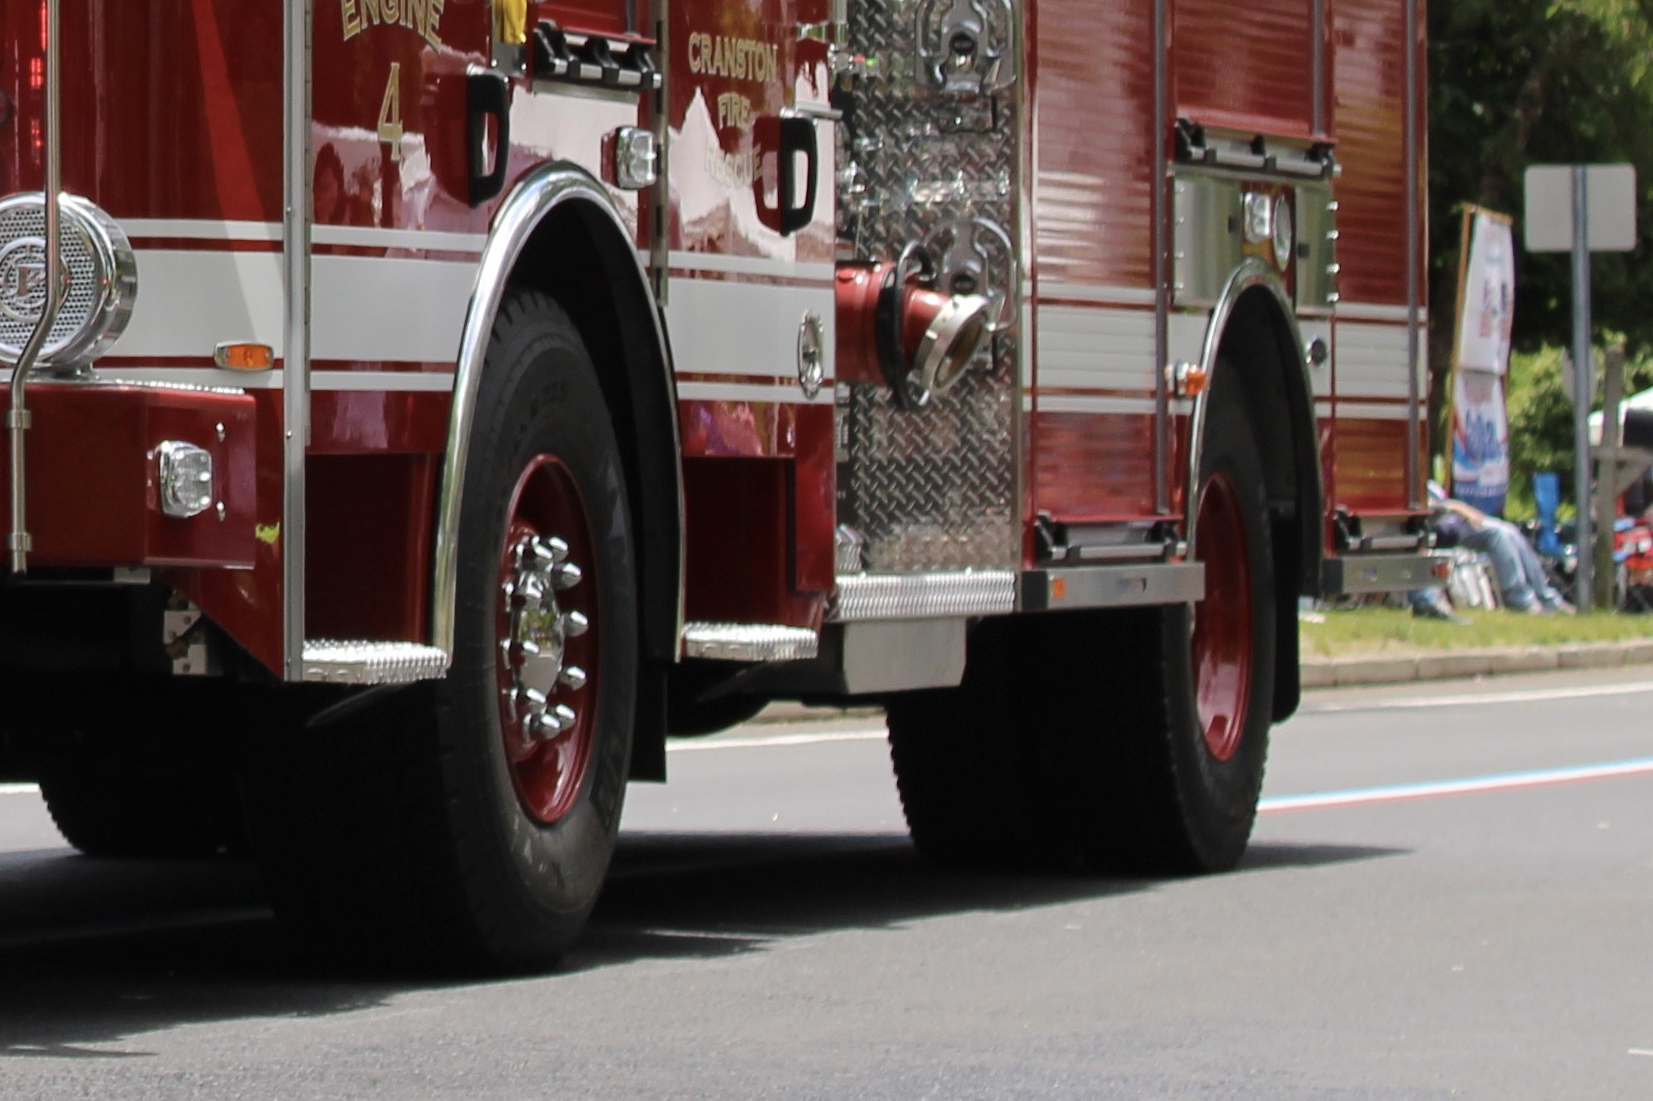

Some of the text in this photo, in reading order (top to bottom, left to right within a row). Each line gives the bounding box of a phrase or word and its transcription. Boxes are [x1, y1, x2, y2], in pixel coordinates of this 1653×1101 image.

[689, 32, 778, 82] CRANSTON
[377, 62, 403, 162] 4
[718, 92, 751, 134] FIRE
